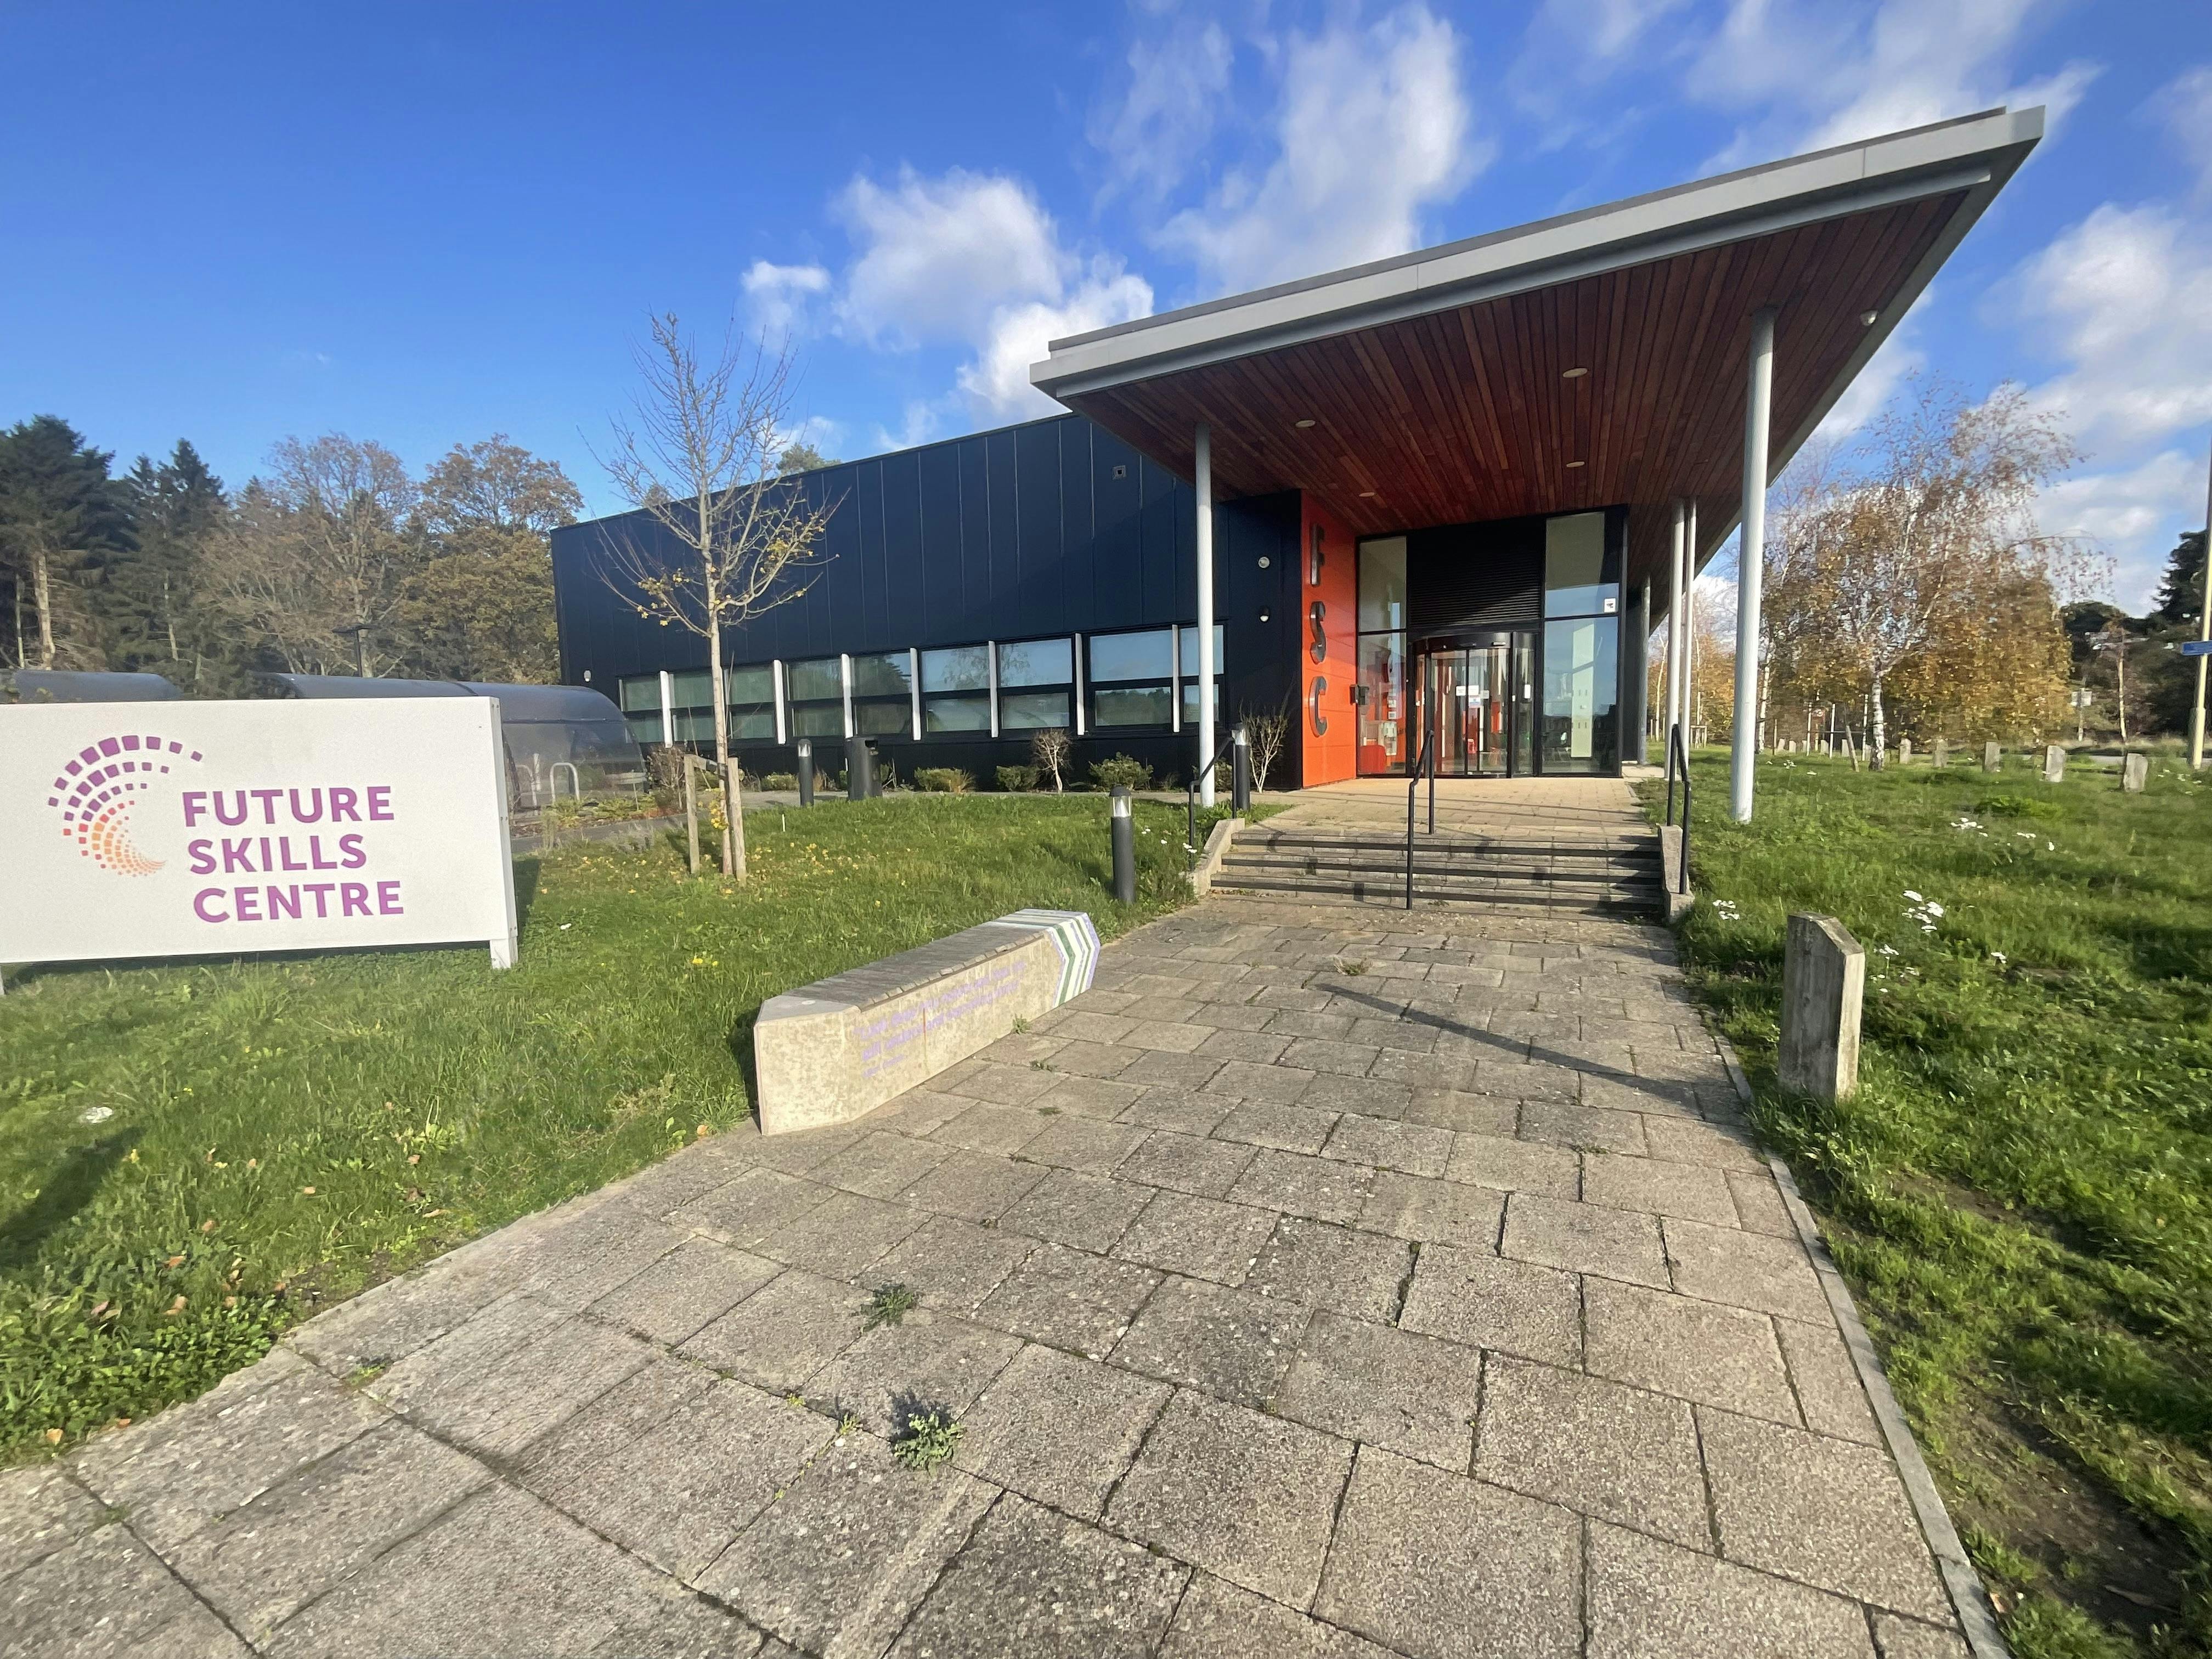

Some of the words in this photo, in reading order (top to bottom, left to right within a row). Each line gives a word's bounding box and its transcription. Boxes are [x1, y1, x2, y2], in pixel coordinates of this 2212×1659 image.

[1308, 523, 1327, 738] FSC
[183, 786, 394, 827] FUTURE
[188, 834, 367, 874] SKILLS
[194, 881, 404, 923] CENTRE
